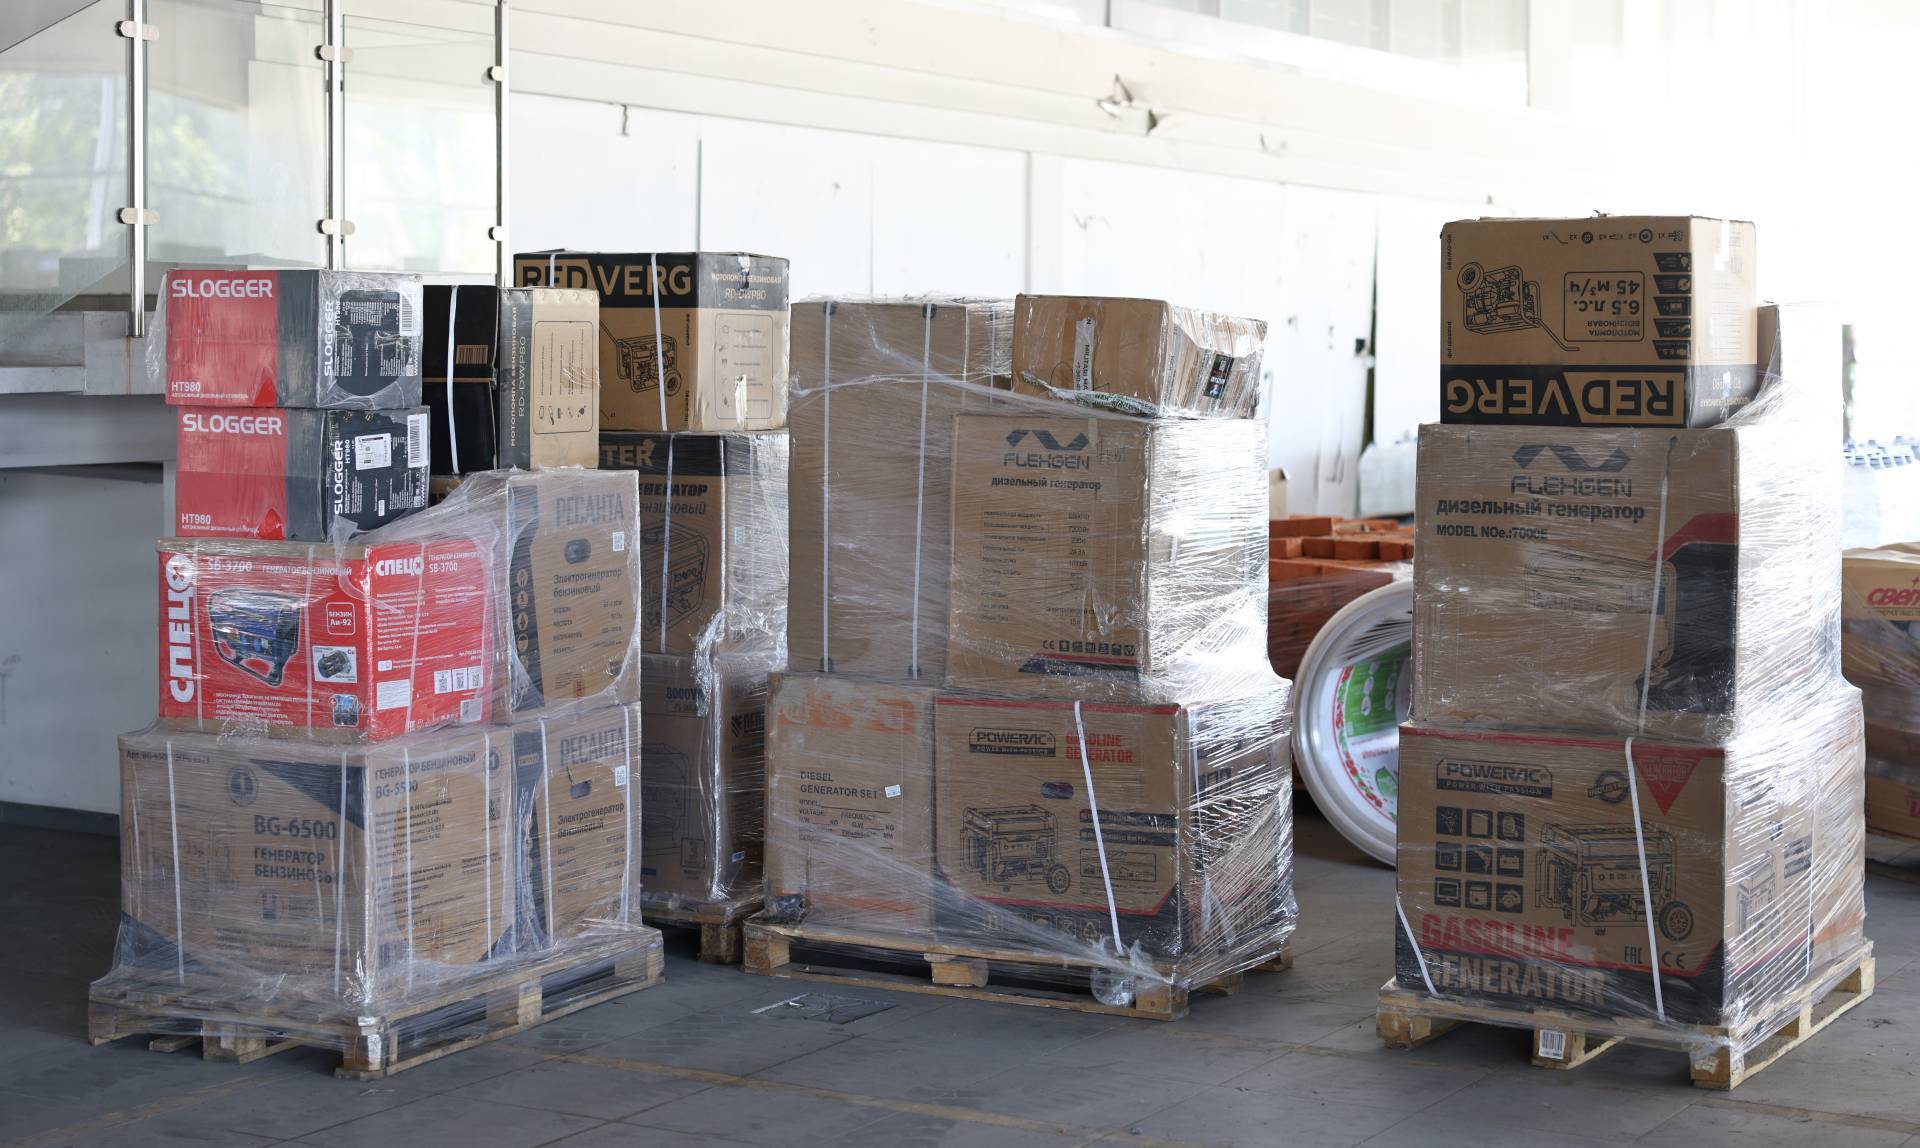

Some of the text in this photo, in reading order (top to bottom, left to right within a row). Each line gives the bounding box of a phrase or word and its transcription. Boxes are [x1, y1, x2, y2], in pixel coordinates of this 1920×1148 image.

[171, 279, 273, 299] SLOGGER
[1617, 279, 1640, 295] 45
[1573, 299, 1640, 315] 6.5 л.с.
[324, 301, 334, 376] SLOGGER
[1588, 329, 1640, 337] МОТОПОМПА
[519, 336, 527, 417] RD-DWP80
[171, 381, 201, 392] HT980
[1447, 379, 1675, 416] REDVERG
[182, 413, 283, 435] SLOGGER
[334, 440, 343, 514] SLOGGER
[991, 476, 1101, 492] дизельный генератор
[181, 513, 212, 525] HT980
[556, 493, 625, 527] РЕСАНТА
[1436, 499, 1645, 524] дизельный генератор
[1436, 525, 1478, 537] MODEL
[207, 559, 253, 573] SB-3700
[429, 562, 458, 573] SB-3700
[560, 727, 626, 767] РЕСАНТА
[800, 770, 833, 782] DIESEL
[800, 784, 879, 800] GENERATOR SET
[1446, 780, 1475, 790] POWER
[1503, 785, 1543, 795] PASSION
[558, 802, 625, 825] Электрогенератор
[254, 815, 336, 841] BG-6500
[254, 847, 325, 866] ГЕНЕРАТОР
[1421, 913, 1576, 954] GASOLINE
